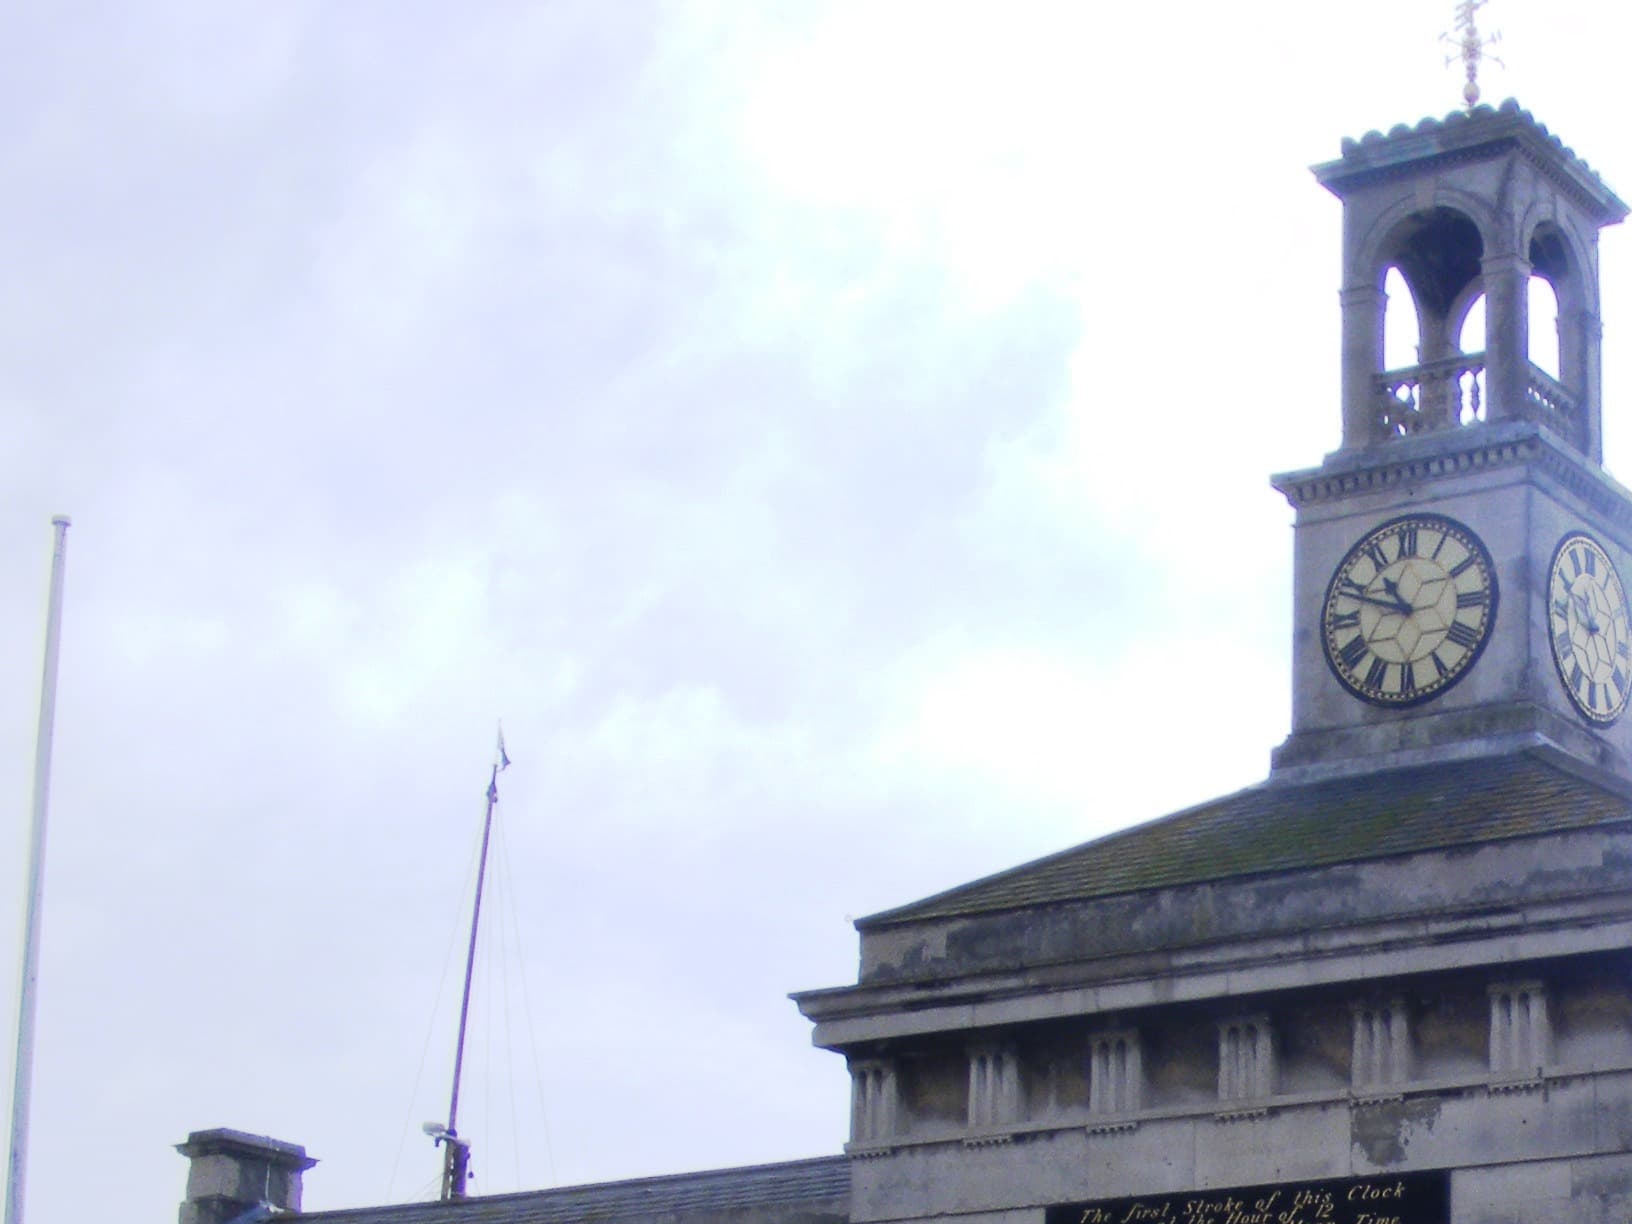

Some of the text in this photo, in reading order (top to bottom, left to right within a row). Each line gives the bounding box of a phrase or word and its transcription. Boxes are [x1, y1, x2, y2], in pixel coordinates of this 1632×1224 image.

[1080, 1181, 1406, 1224] The first Stroke of this Clock
[1278, 1204, 1304, 1224] of
[1315, 1203, 1335, 1219] 12
